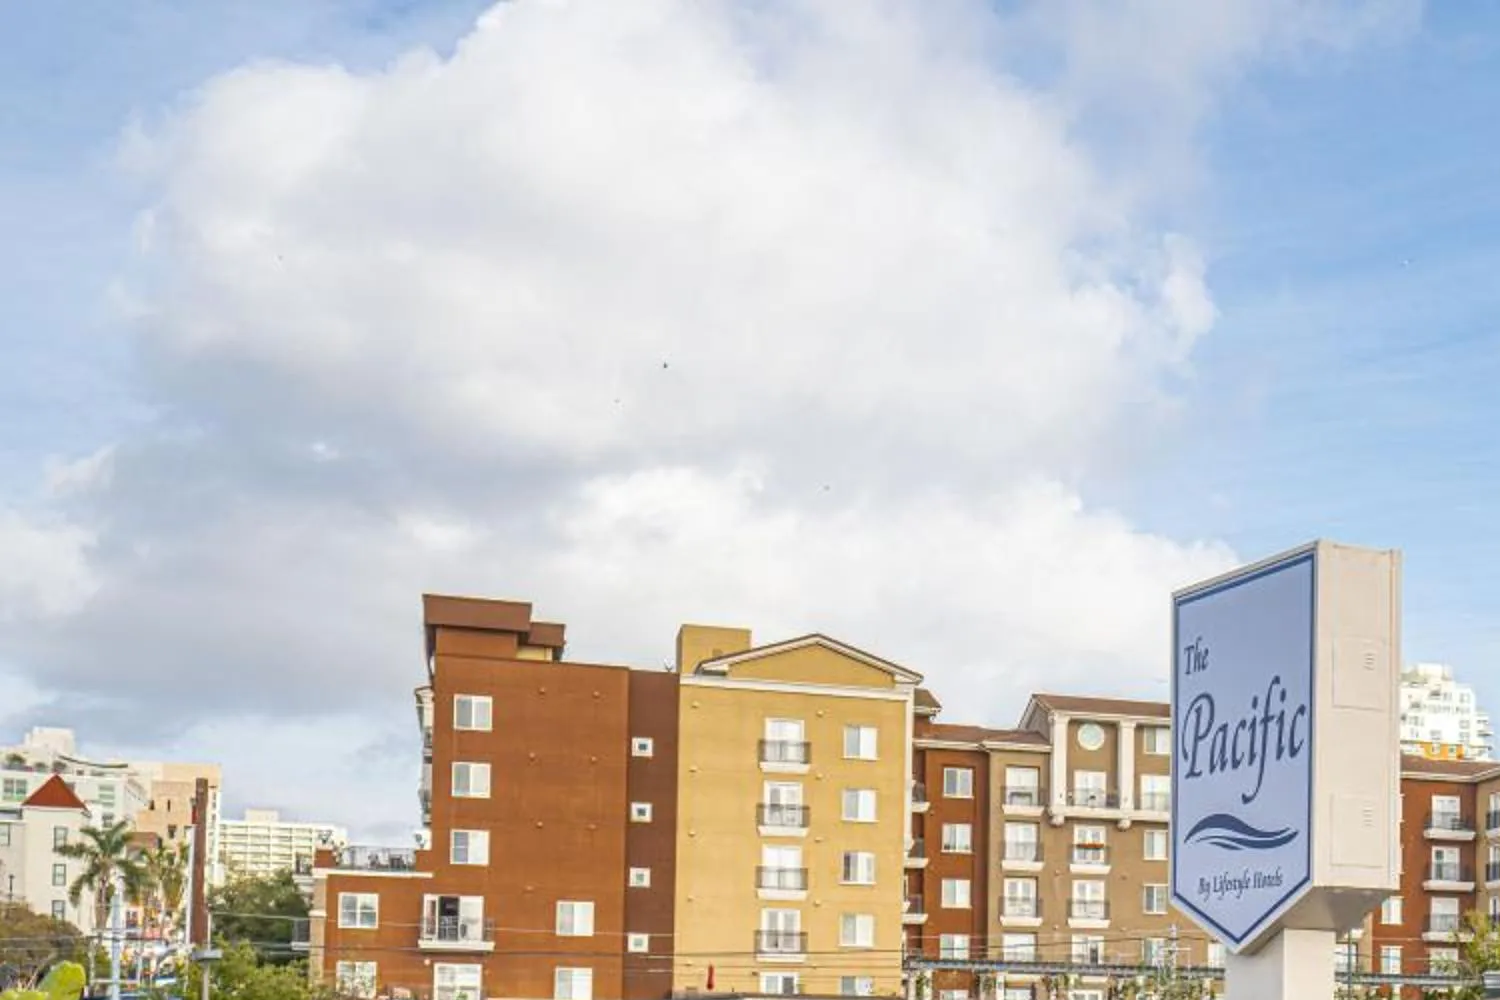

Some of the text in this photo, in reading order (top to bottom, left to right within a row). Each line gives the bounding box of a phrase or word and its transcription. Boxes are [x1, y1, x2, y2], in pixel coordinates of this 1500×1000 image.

[1184, 636, 1209, 675] The
[1181, 674, 1307, 805] Pacific
[1198, 866, 1284, 903] By Lifestyle Hotels
